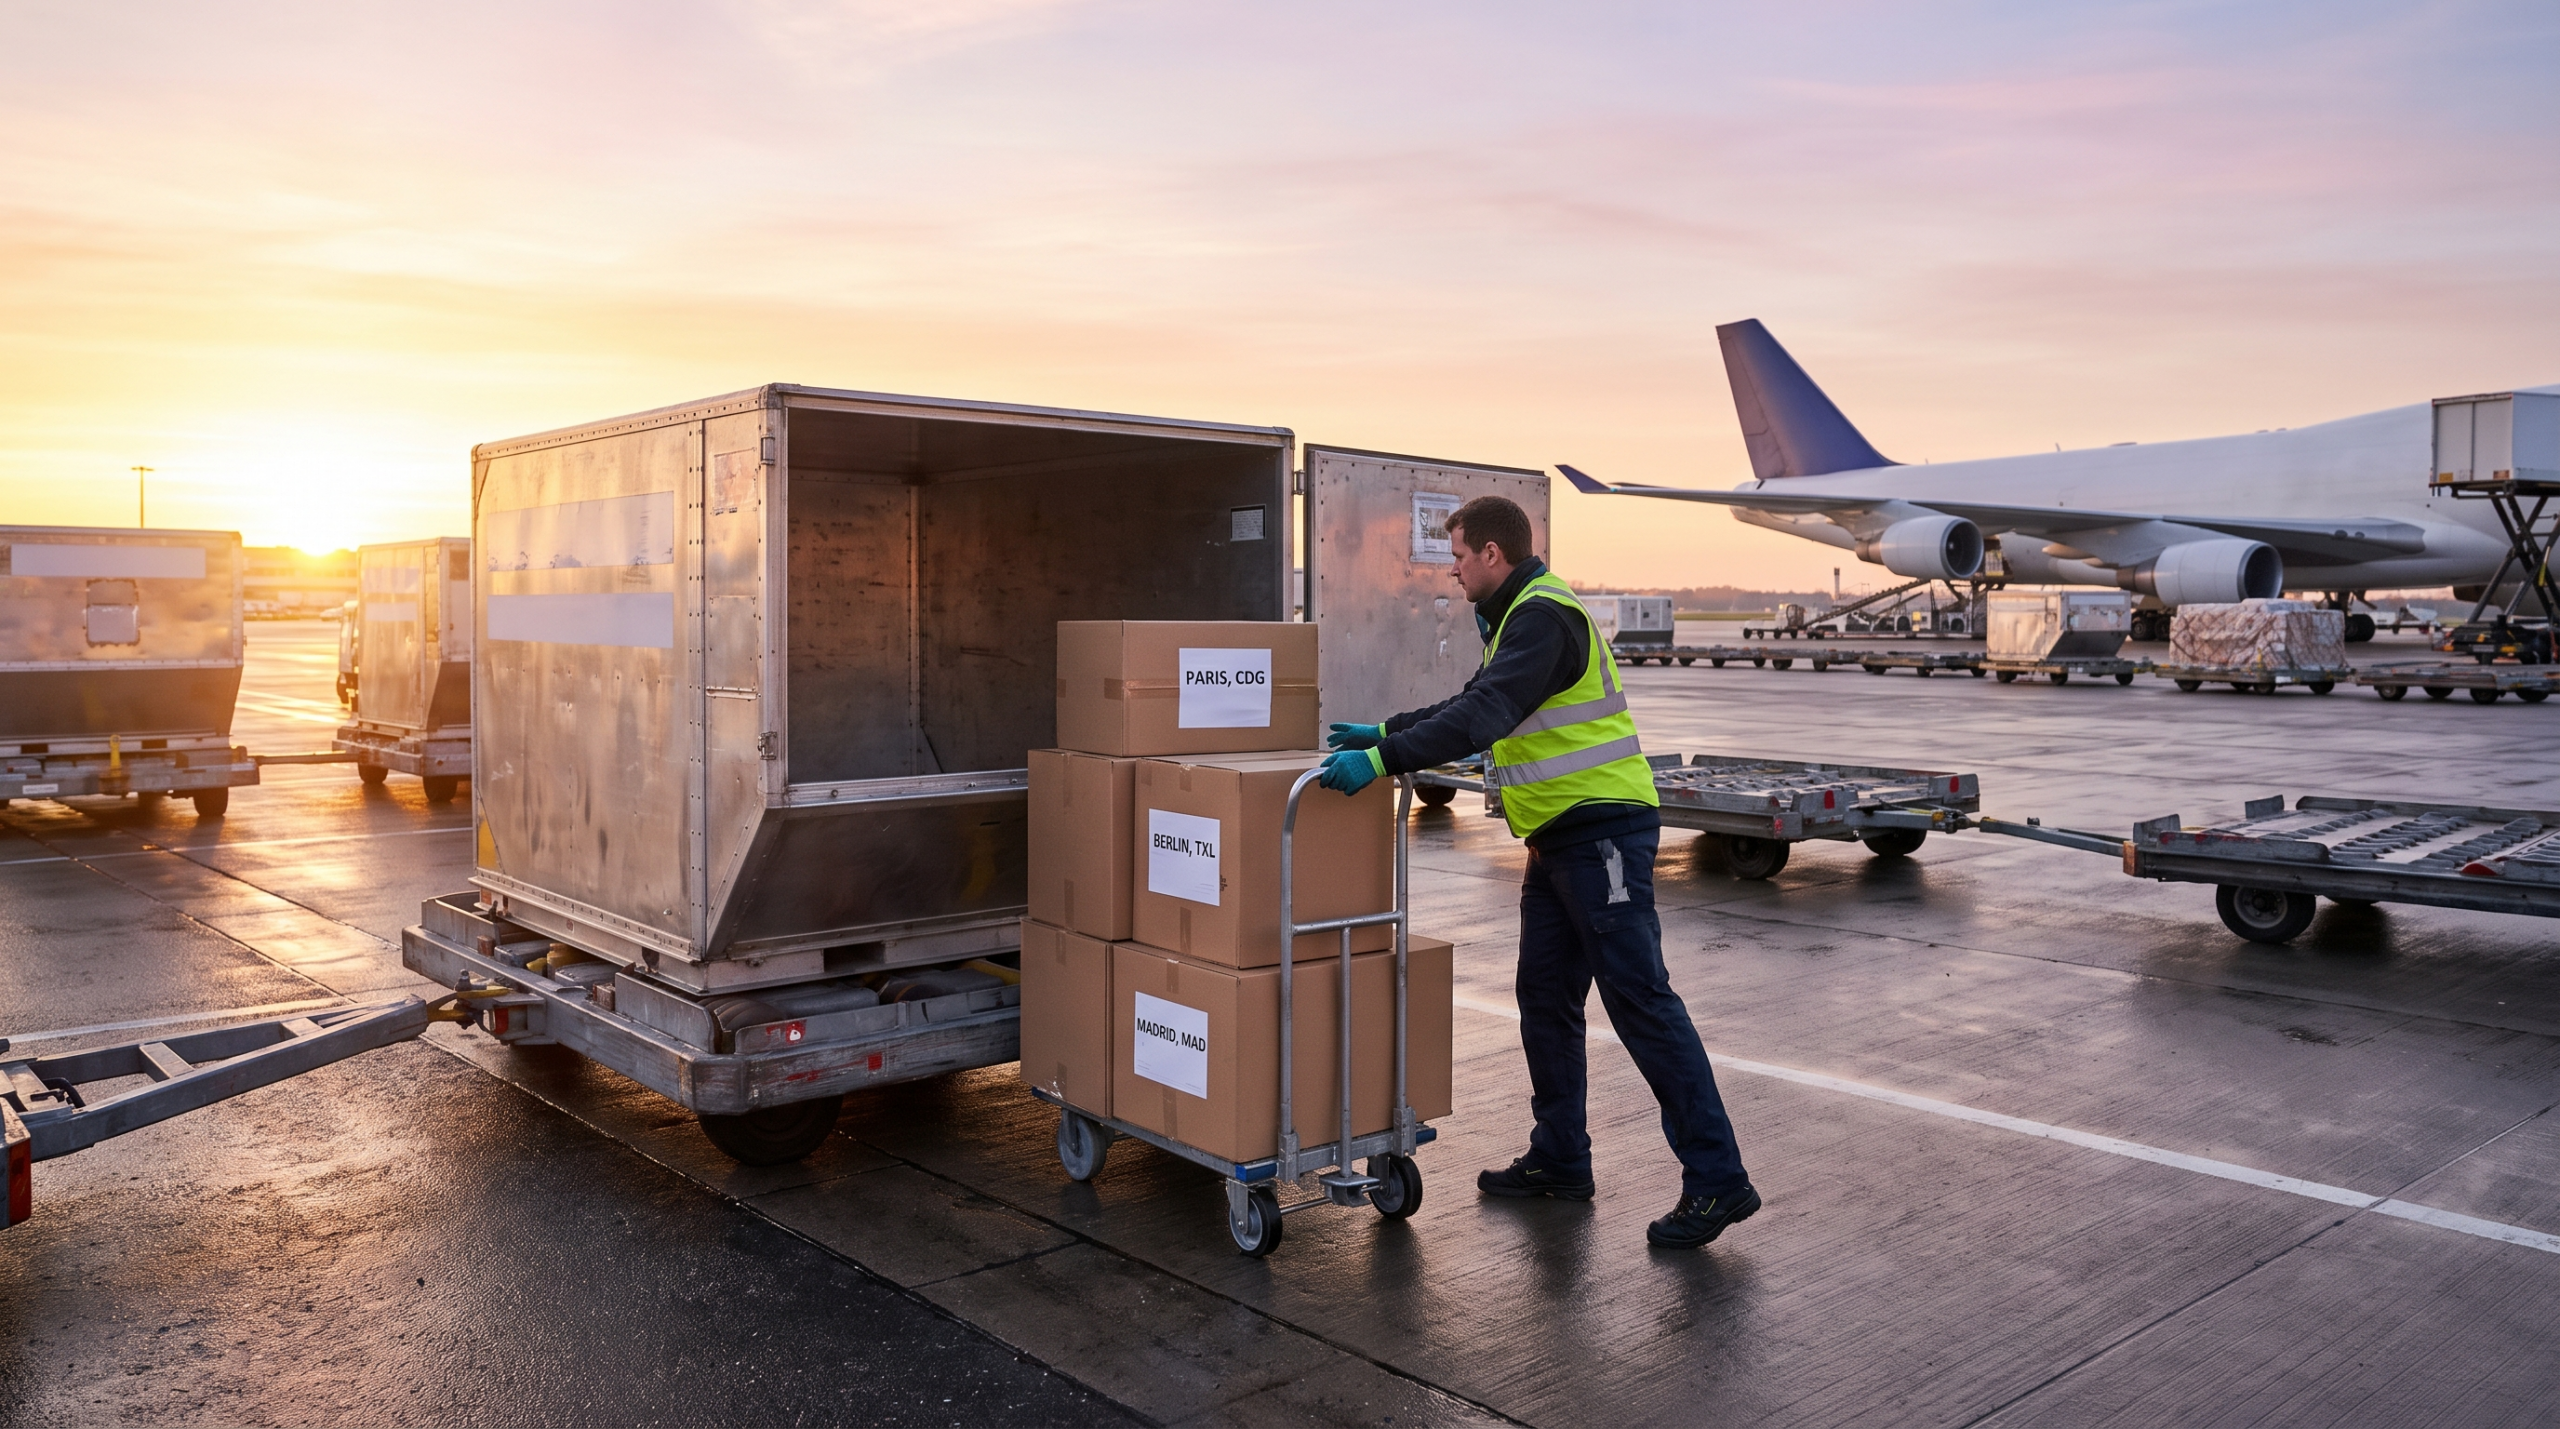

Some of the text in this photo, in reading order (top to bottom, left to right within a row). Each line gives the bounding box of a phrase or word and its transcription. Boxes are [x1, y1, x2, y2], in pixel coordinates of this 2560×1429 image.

[1186, 671, 1265, 687] PARIS, CDG
[1154, 833, 1215, 858] BERLIN, TXL
[1137, 1018, 1206, 1052] MADRID, MAD
